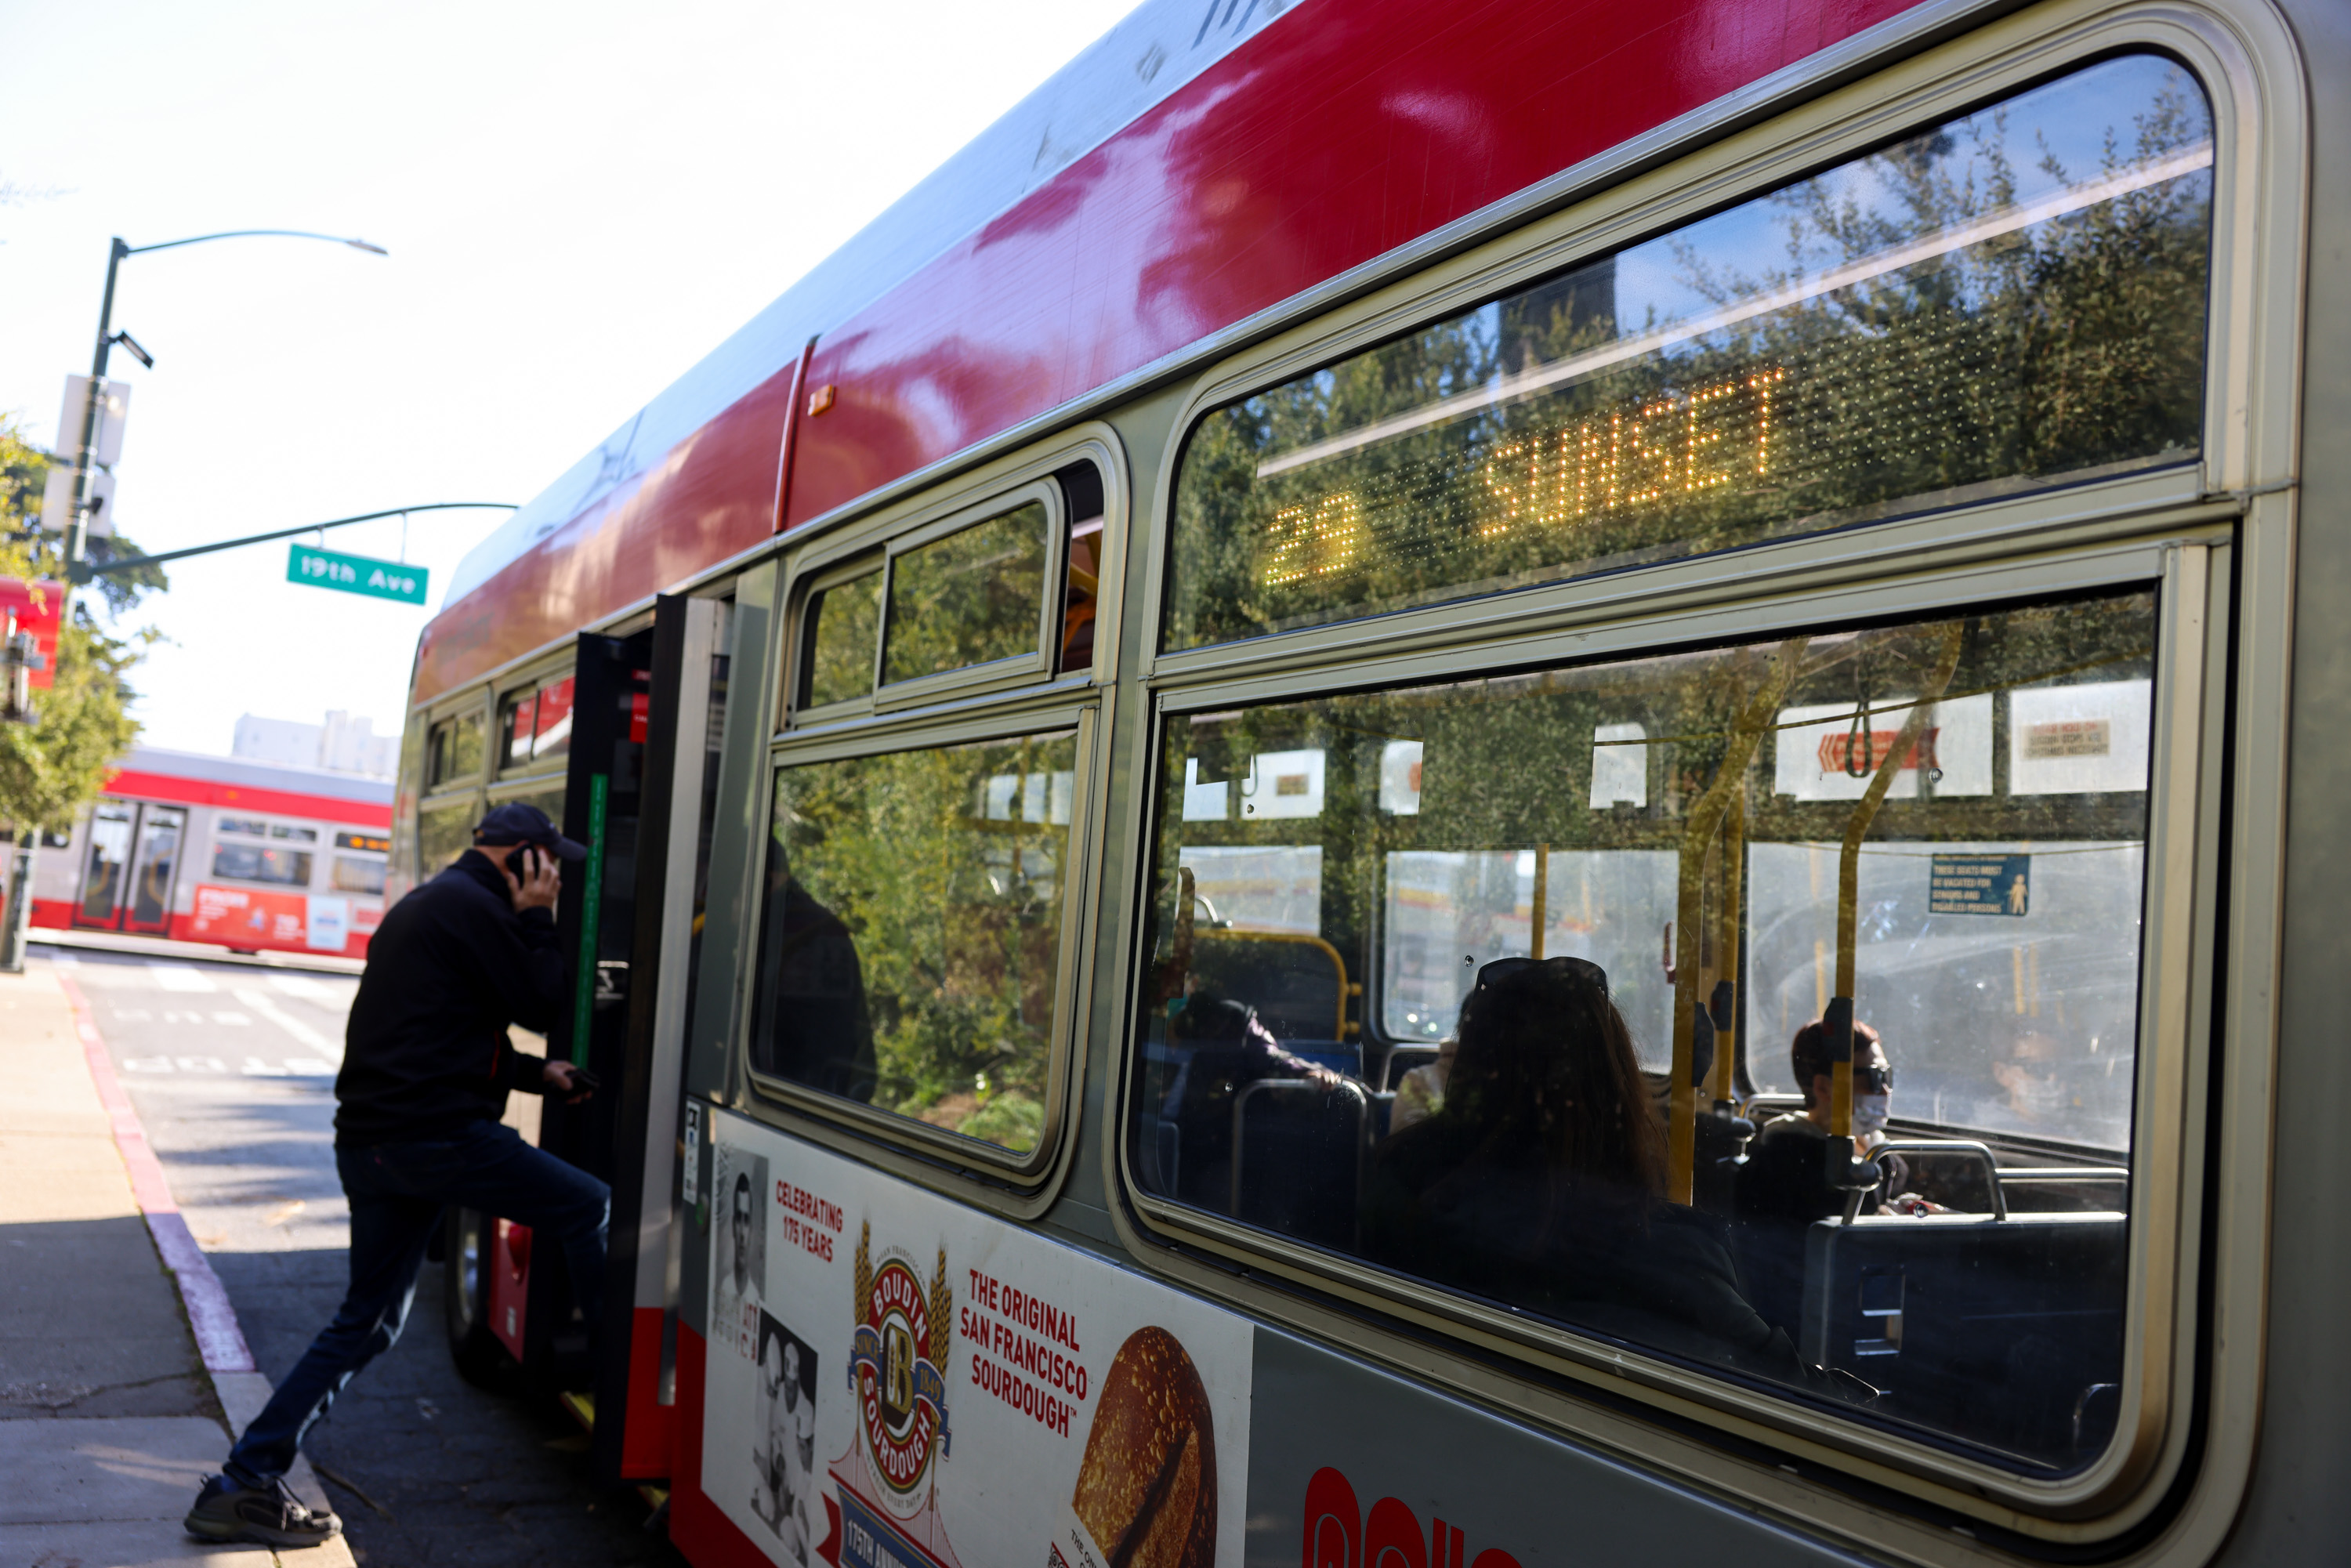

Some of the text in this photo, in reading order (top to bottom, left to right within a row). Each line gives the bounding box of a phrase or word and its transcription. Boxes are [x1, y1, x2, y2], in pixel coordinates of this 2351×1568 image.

[1265, 371, 1783, 586] 29 SUNSET
[301, 555, 417, 595] 19th Ave
[1932, 878, 1991, 889] BE VACATED FOR
[1933, 865, 2003, 876] THESE SEATS MUST
[1964, 890, 1980, 901] AND
[1968, 903, 2001, 914] PERSONS
[122, 1056, 339, 1077] STOP
[776, 1179, 843, 1233] CELEBRATING
[784, 1215, 833, 1263] 175 YEARS
[873, 1273, 927, 1342] BOUDIN
[969, 1268, 1080, 1353] THE ORIGINAL
[855, 1334, 879, 1363] SINCE
[960, 1306, 1087, 1401] SAN FRANCISCO
[919, 1368, 941, 1402] 1849
[864, 1376, 931, 1479] SOURDOUGH
[847, 1519, 874, 1567] 175TH
[1071, 1529, 1084, 1555] THE
